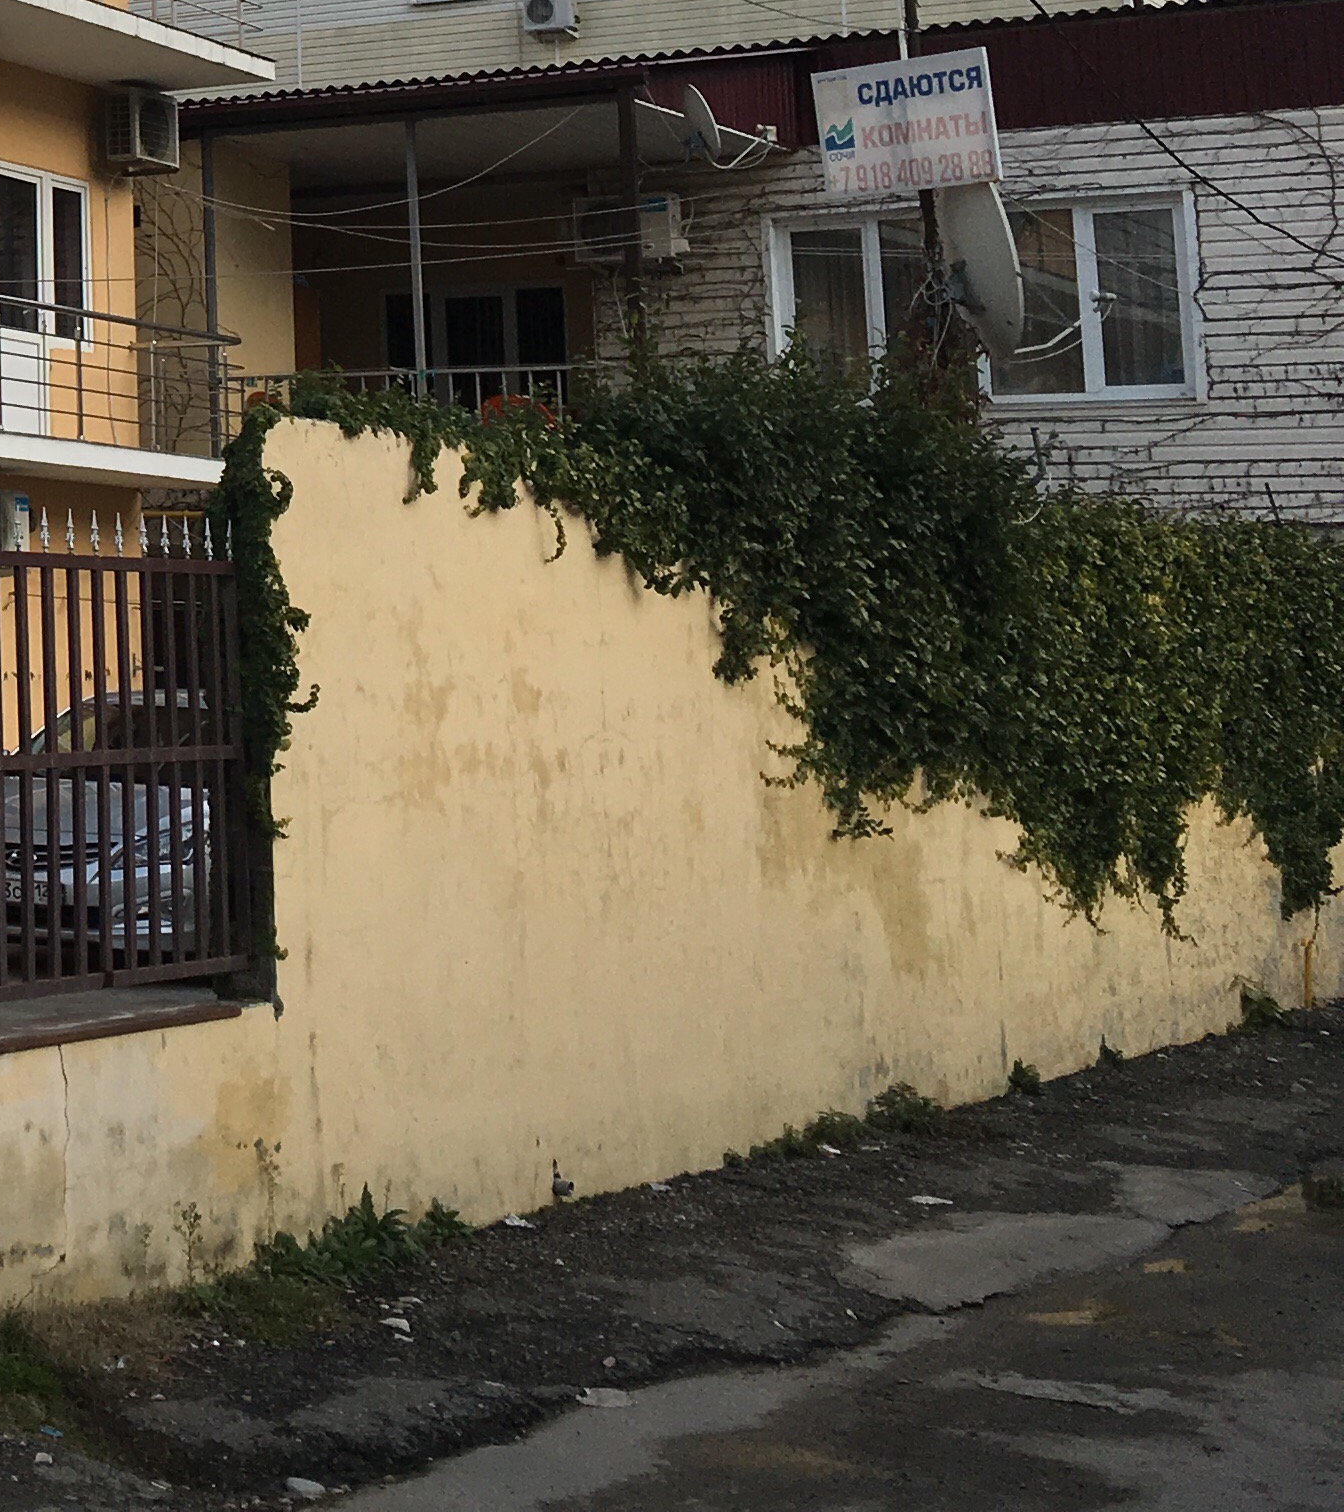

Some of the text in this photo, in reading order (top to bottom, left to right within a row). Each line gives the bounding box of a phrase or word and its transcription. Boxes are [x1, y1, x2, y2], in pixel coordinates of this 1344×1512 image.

[857, 66, 983, 107] СДАЮТСЯ
[862, 111, 988, 149] КОМНАТЫ
[856, 161, 892, 192] 918
[898, 156, 933, 186] 409
[939, 152, 963, 183] 28
